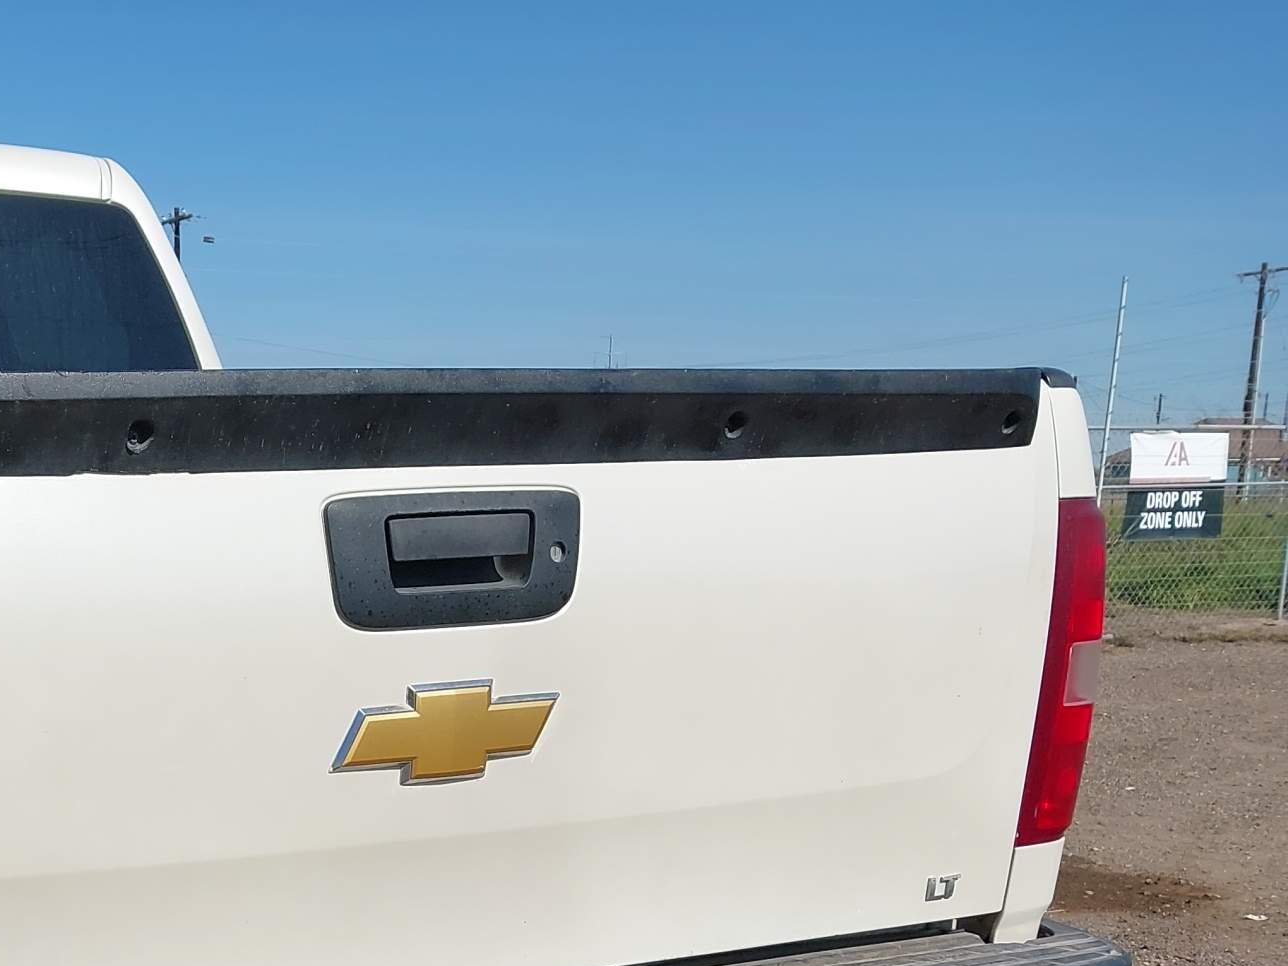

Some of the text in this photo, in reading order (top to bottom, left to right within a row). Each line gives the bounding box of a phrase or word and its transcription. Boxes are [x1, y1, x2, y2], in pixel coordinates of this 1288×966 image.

[1146, 490, 1203, 509] DROP OFF
[1139, 511, 1206, 529] ZONE ONLY
[925, 874, 961, 902] LT
